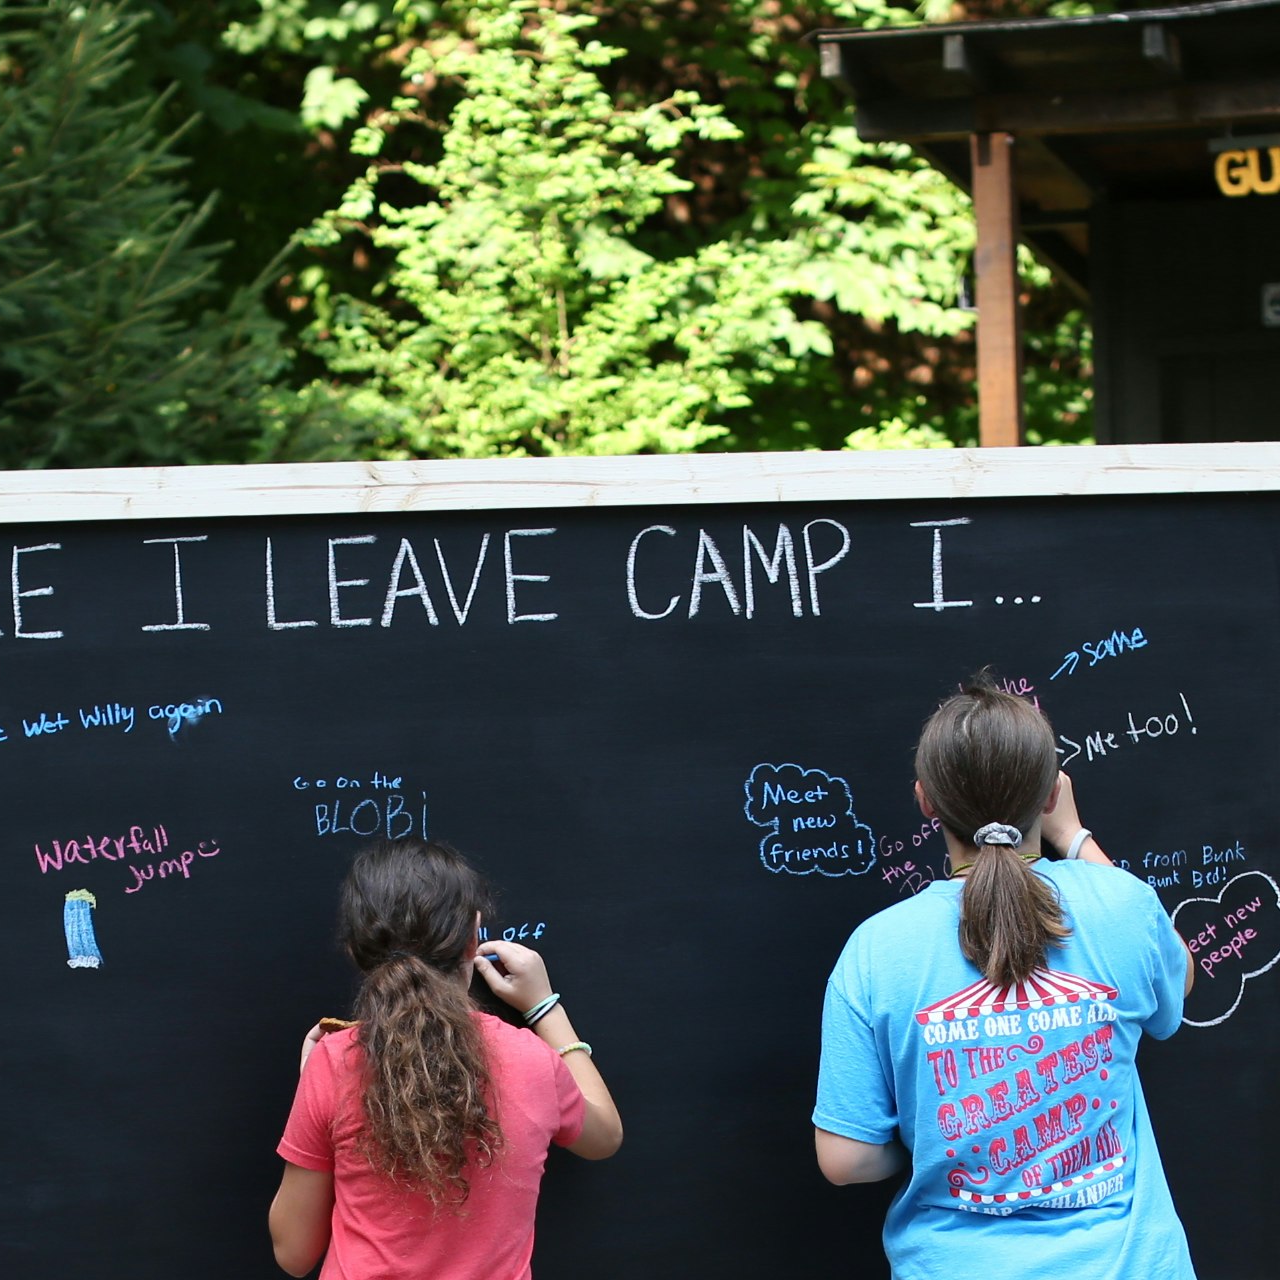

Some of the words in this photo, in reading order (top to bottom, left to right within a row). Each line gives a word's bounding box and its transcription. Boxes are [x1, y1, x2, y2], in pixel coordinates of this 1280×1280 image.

[141, 535, 211, 632] I
[265, 527, 559, 631] LEAVE
[626, 518, 852, 620] CAMP
[148, 698, 223, 740] again
[1125, 692, 1197, 744] too!
[293, 776, 327, 790] Go
[370, 771, 402, 790] the
[762, 781, 829, 809] Meet
[792, 814, 837, 833] new
[879, 835, 905, 857] Go
[912, 817, 941, 847] off
[769, 839, 865, 866] friends!
[882, 860, 917, 884] the
[1142, 850, 1187, 869] from
[1202, 840, 1246, 866] Bunk
[1146, 869, 1181, 888] Bunk
[502, 922, 546, 942] off
[1188, 922, 1217, 953] eet
[1223, 896, 1262, 929] new
[1200, 928, 1258, 979] people
[923, 1019, 980, 1046] COME
[984, 1014, 1021, 1037] ONE
[1027, 1006, 1083, 1032] COME
[1087, 1002, 1118, 1024] ALL
[927, 1048, 958, 1096] TO
[962, 1046, 1005, 1079] THE
[937, 1023, 1114, 1142] GREATEST
[988, 1092, 1088, 1176] CAMP
[1022, 1163, 1043, 1188] OF
[1045, 1136, 1091, 1181] THEM
[1095, 1119, 1122, 1163] ALL
